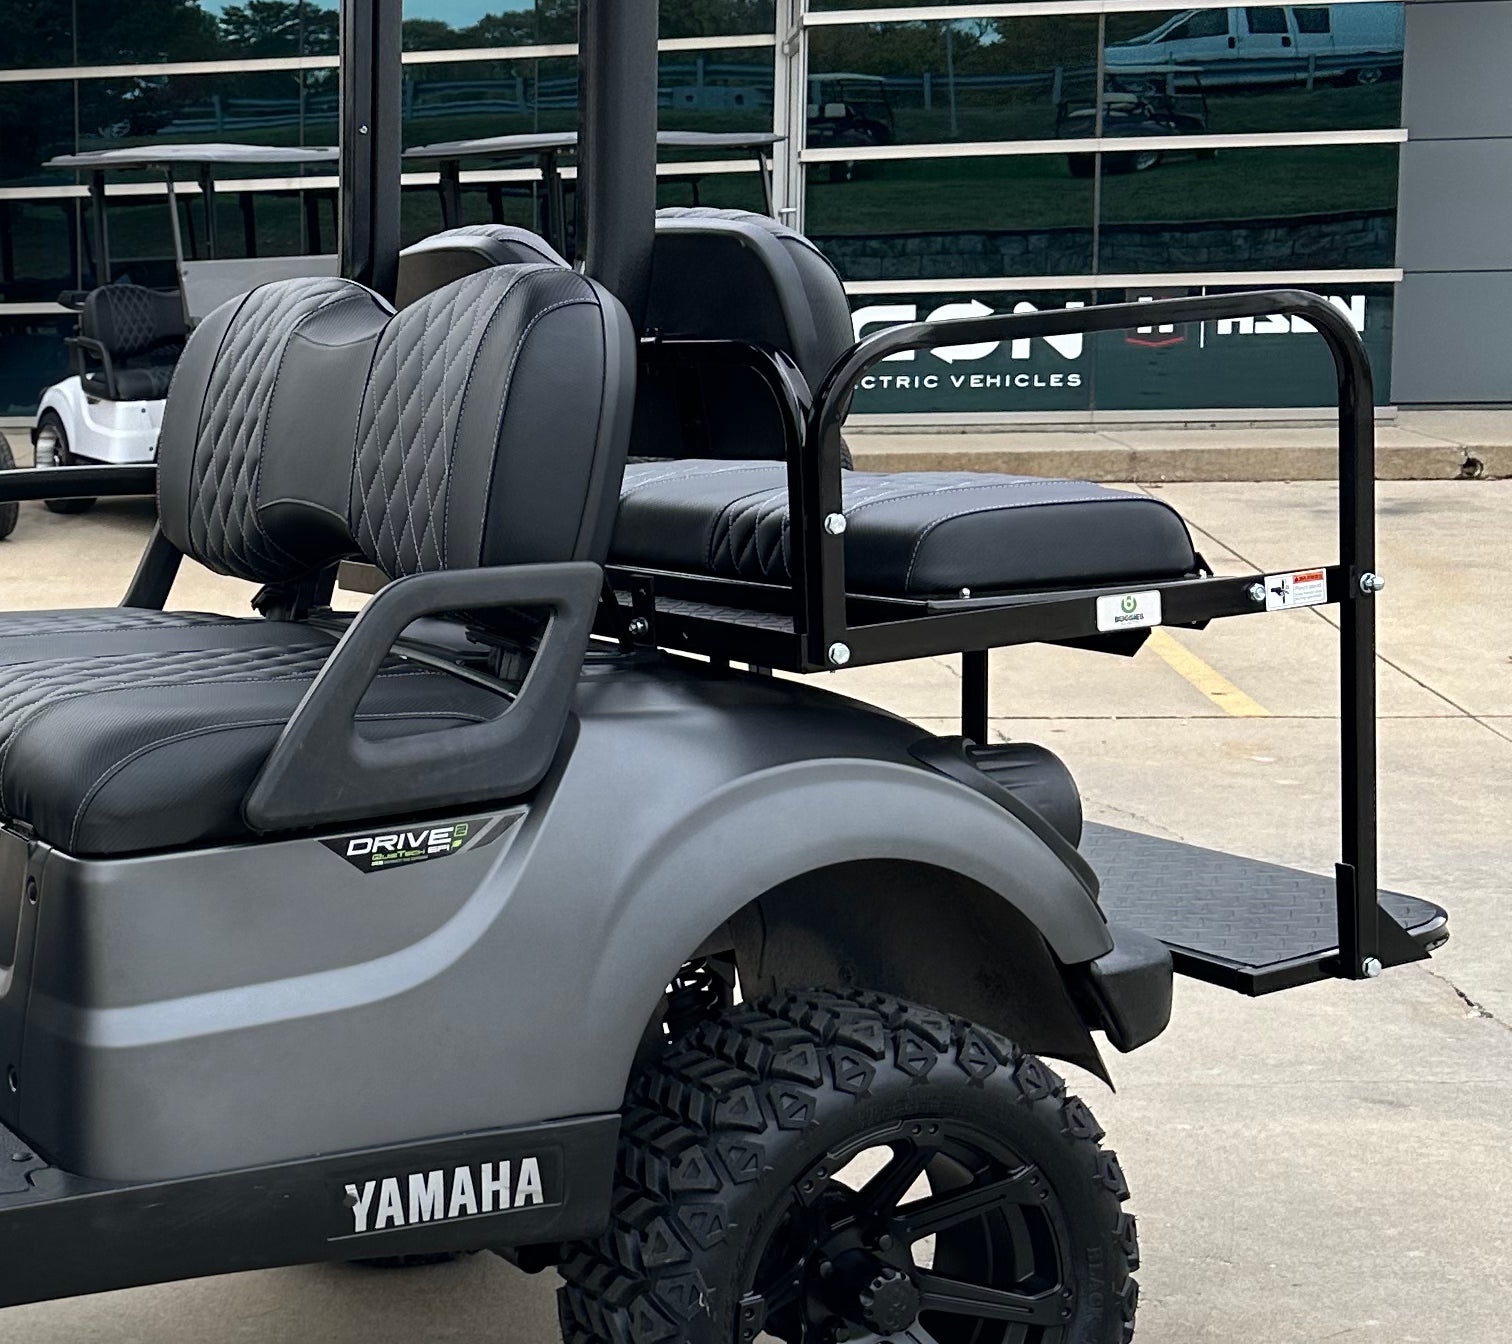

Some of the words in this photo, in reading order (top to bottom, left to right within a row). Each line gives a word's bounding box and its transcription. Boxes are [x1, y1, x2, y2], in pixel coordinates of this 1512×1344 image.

[854, 374, 938, 390] CTRIC
[950, 373, 1082, 389] VEHICLES
[346, 826, 454, 856] DRIVE
[345, 1156, 544, 1233] YAMAHA
